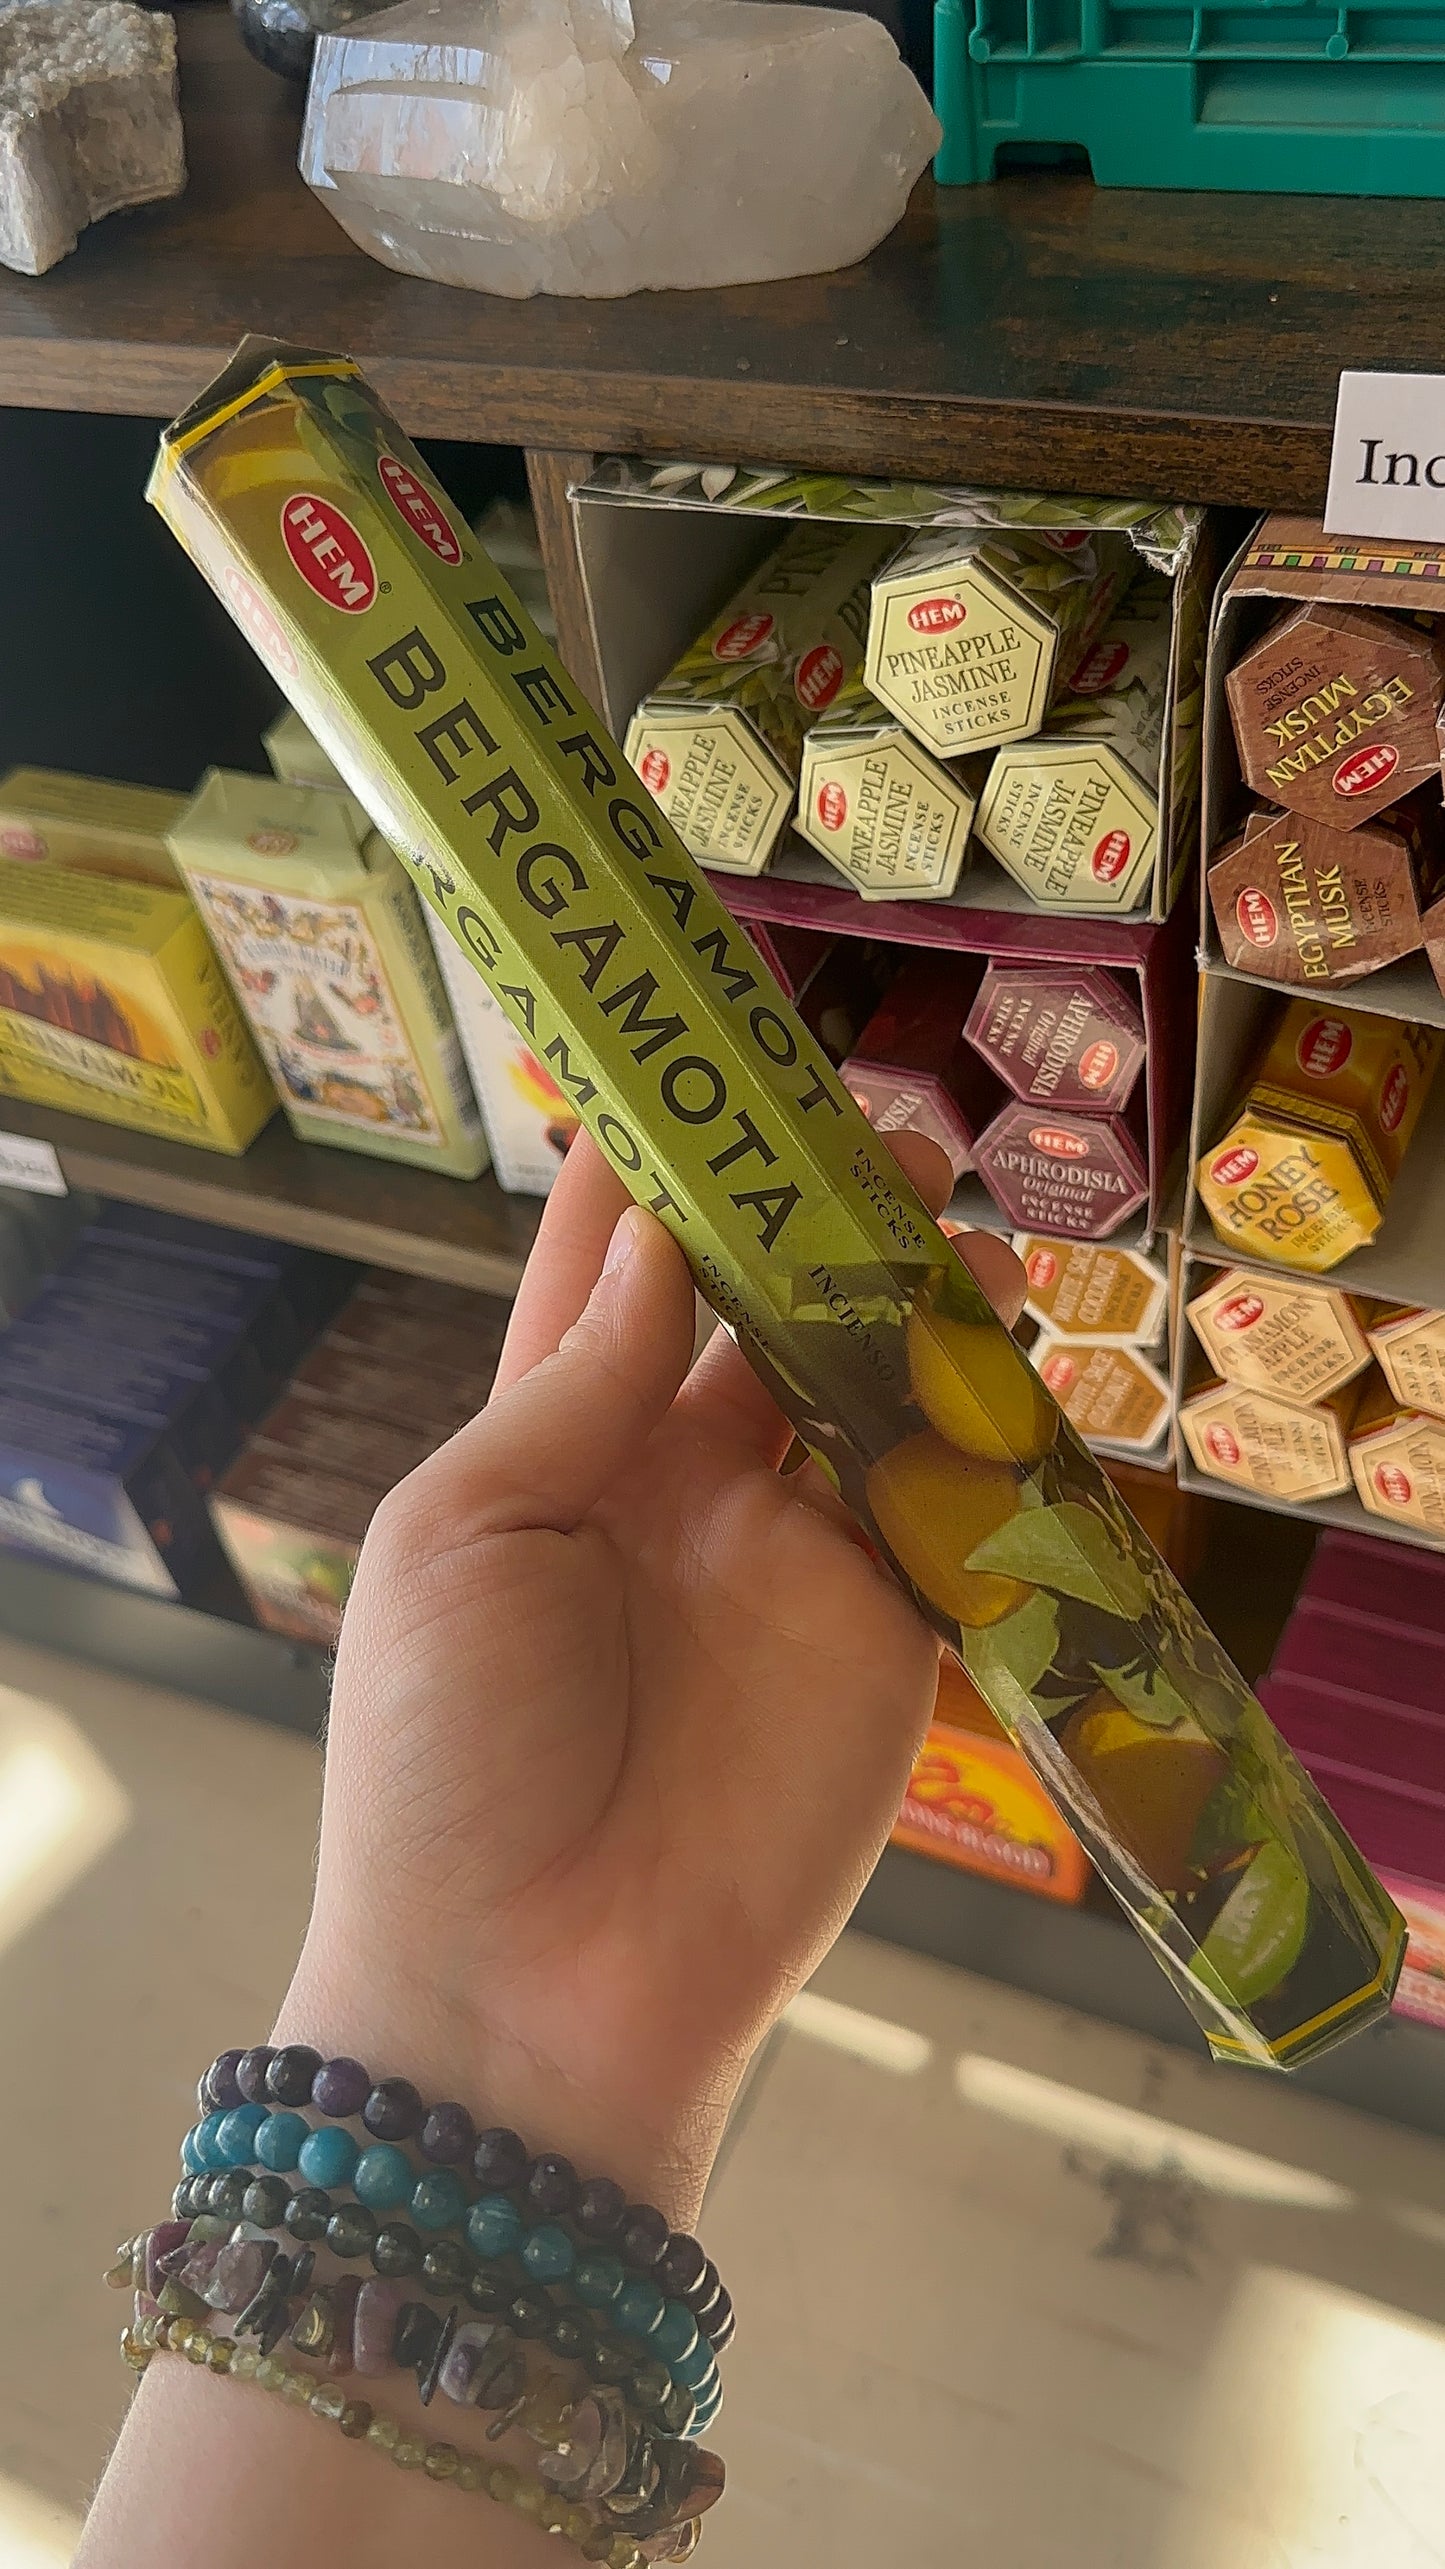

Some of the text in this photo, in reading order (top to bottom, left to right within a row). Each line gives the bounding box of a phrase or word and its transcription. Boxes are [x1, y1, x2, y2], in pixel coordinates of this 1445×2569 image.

[385, 466, 456, 557] HEM
[288, 502, 370, 607] HEM
[910, 603, 964, 629] HEM
[800, 649, 843, 705] HEM
[885, 627, 1021, 678] PINEAPPLE
[911, 658, 1017, 704] JASMINE
[1256, 656, 1304, 694] STICKS
[931, 691, 1011, 720] INCENSE
[1263, 664, 1321, 710] INCENSE
[1263, 671, 1359, 748] MUSK
[944, 708, 1011, 735] STICKS
[1264, 675, 1415, 789] EGYPTIAN
[668, 733, 717, 833] NEAPPLE
[1337, 748, 1395, 792] HEM
[689, 758, 738, 848] JASMINE
[823, 783, 844, 831] HEM
[850, 758, 889, 875] PINEAPPLE
[876, 778, 913, 877] JASMINE
[996, 780, 1024, 835] STICKS
[1009, 782, 1043, 849] INCENSE
[1023, 778, 1076, 873] JASMINE
[463, 595, 845, 1117] BERGAMOT
[903, 800, 930, 872] INCENSE
[921, 811, 945, 872] STICKS
[1044, 777, 1111, 897] PINEAPPLE
[1095, 831, 1129, 882] HEM
[1243, 892, 1271, 944] HEM
[1273, 840, 1330, 979] EGYPTIAN
[1313, 864, 1358, 950] MUSK
[365, 626, 804, 1254] BERGAMOTA
[412, 848, 690, 1223] RGAMOT
[1021, 1009, 1058, 1069] Original
[1029, 990, 1094, 1097] APHRODISIA
[1084, 1043, 1113, 1085] HEM
[1305, 1020, 1345, 1074] HEM
[1381, 1071, 1408, 1128] HEM
[992, 1150, 1129, 1196] APHRODISIA
[1034, 1133, 1086, 1154] HEM
[1213, 1148, 1257, 1184] HEM
[849, 1164, 910, 1250] STICKS
[855, 1147, 926, 1249] INCENSE
[1021, 1193, 1095, 1220] INCENSE
[1022, 1175, 1097, 1203] Original
[1225, 1144, 1321, 1228] HONEY
[1255, 1176, 1341, 1243] ROSE
[808, 1264, 895, 1381] INCIENSO
